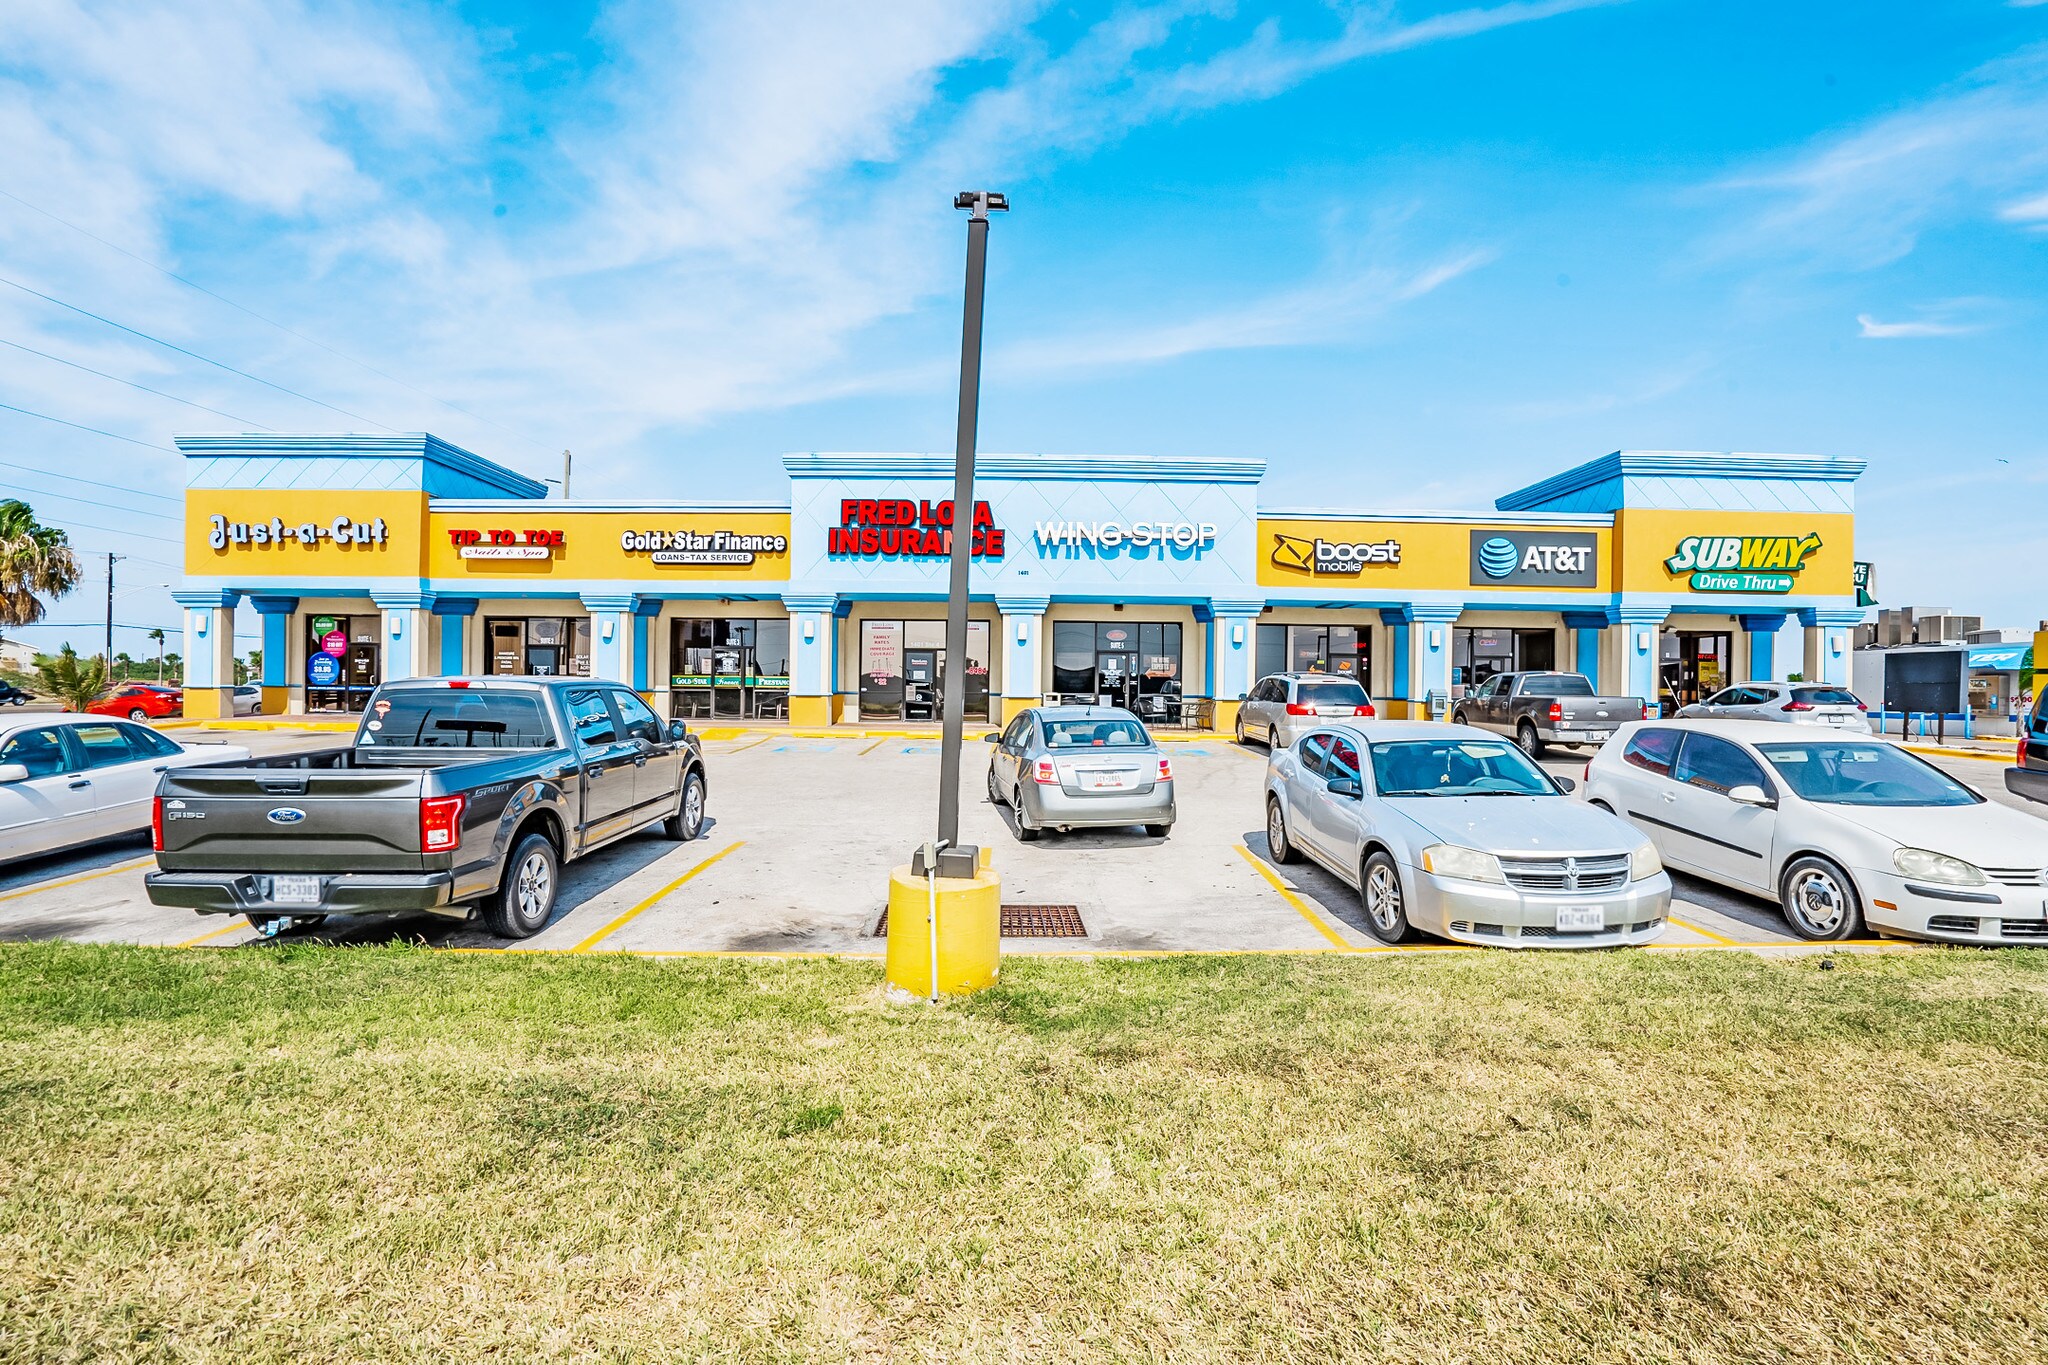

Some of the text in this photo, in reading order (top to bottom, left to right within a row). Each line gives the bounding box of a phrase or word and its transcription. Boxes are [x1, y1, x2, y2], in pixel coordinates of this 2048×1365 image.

[841, 499, 993, 527] FRED LOA
[447, 529, 564, 546] TIP TO TOE
[621, 531, 787, 551] Gold Star Finance
[465, 548, 544, 558] Nails & Spa
[1316, 539, 1400, 562] boost
[1671, 536, 1820, 570] SUBWAY
[655, 553, 749, 562] LOANS-TAX SERVICE
[1520, 545, 1592, 572] AT&T
[1317, 561, 1362, 572] mobile
[1700, 574, 1777, 590] Drive Thru
[357, 635, 369, 643] SUITE
[1110, 641, 1121, 649] SUITE
[676, 677, 708, 685] GOLD STAR
[472, 782, 514, 799] SPORT
[168, 811, 206, 821] F150
[275, 810, 298, 821] Ford
